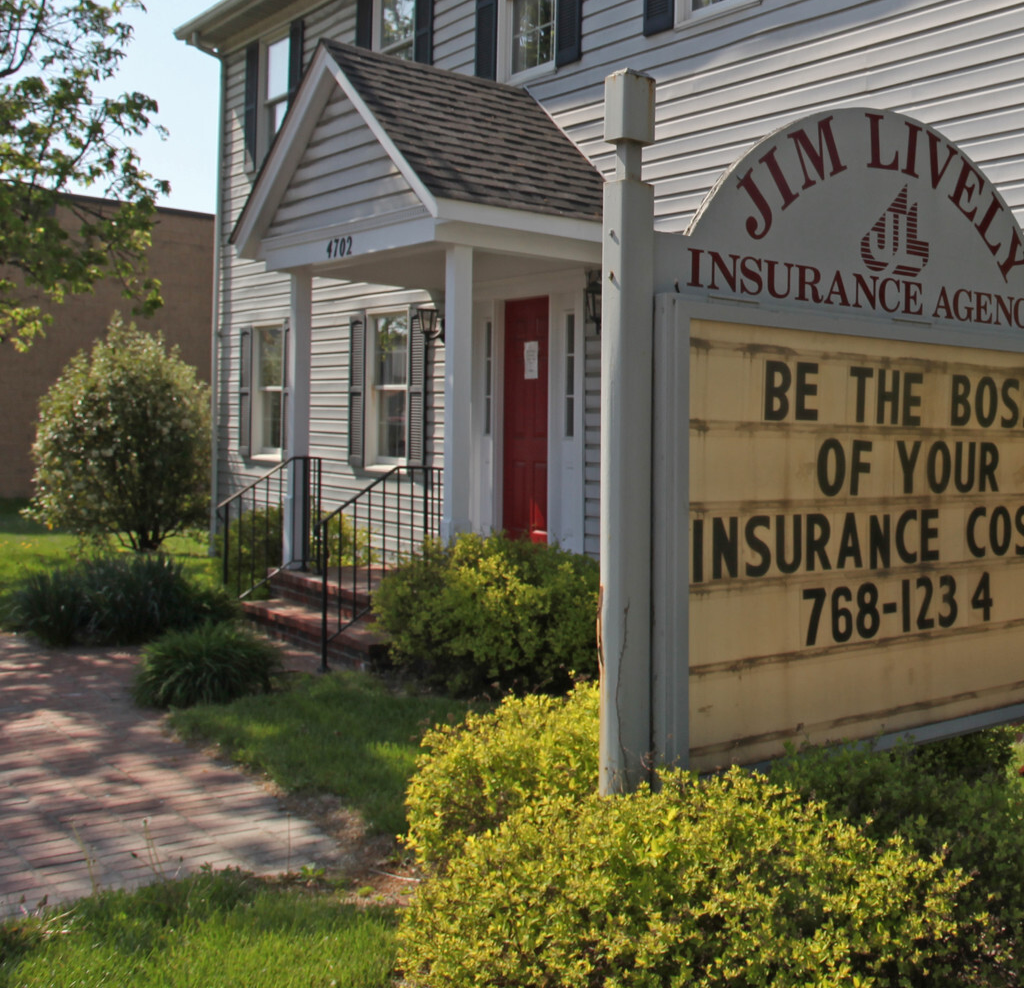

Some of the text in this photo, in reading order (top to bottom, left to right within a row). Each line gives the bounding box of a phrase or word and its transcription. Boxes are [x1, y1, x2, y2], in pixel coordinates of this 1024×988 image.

[737, 118, 847, 240] JIM
[326, 236, 353, 259] 4702
[687, 248, 923, 315] INSURANCE
[764, 361, 819, 421] BE
[850, 366, 924, 427] THE
[816, 438, 1000, 497] OF YOUR
[692, 508, 939, 583] INSURANCE
